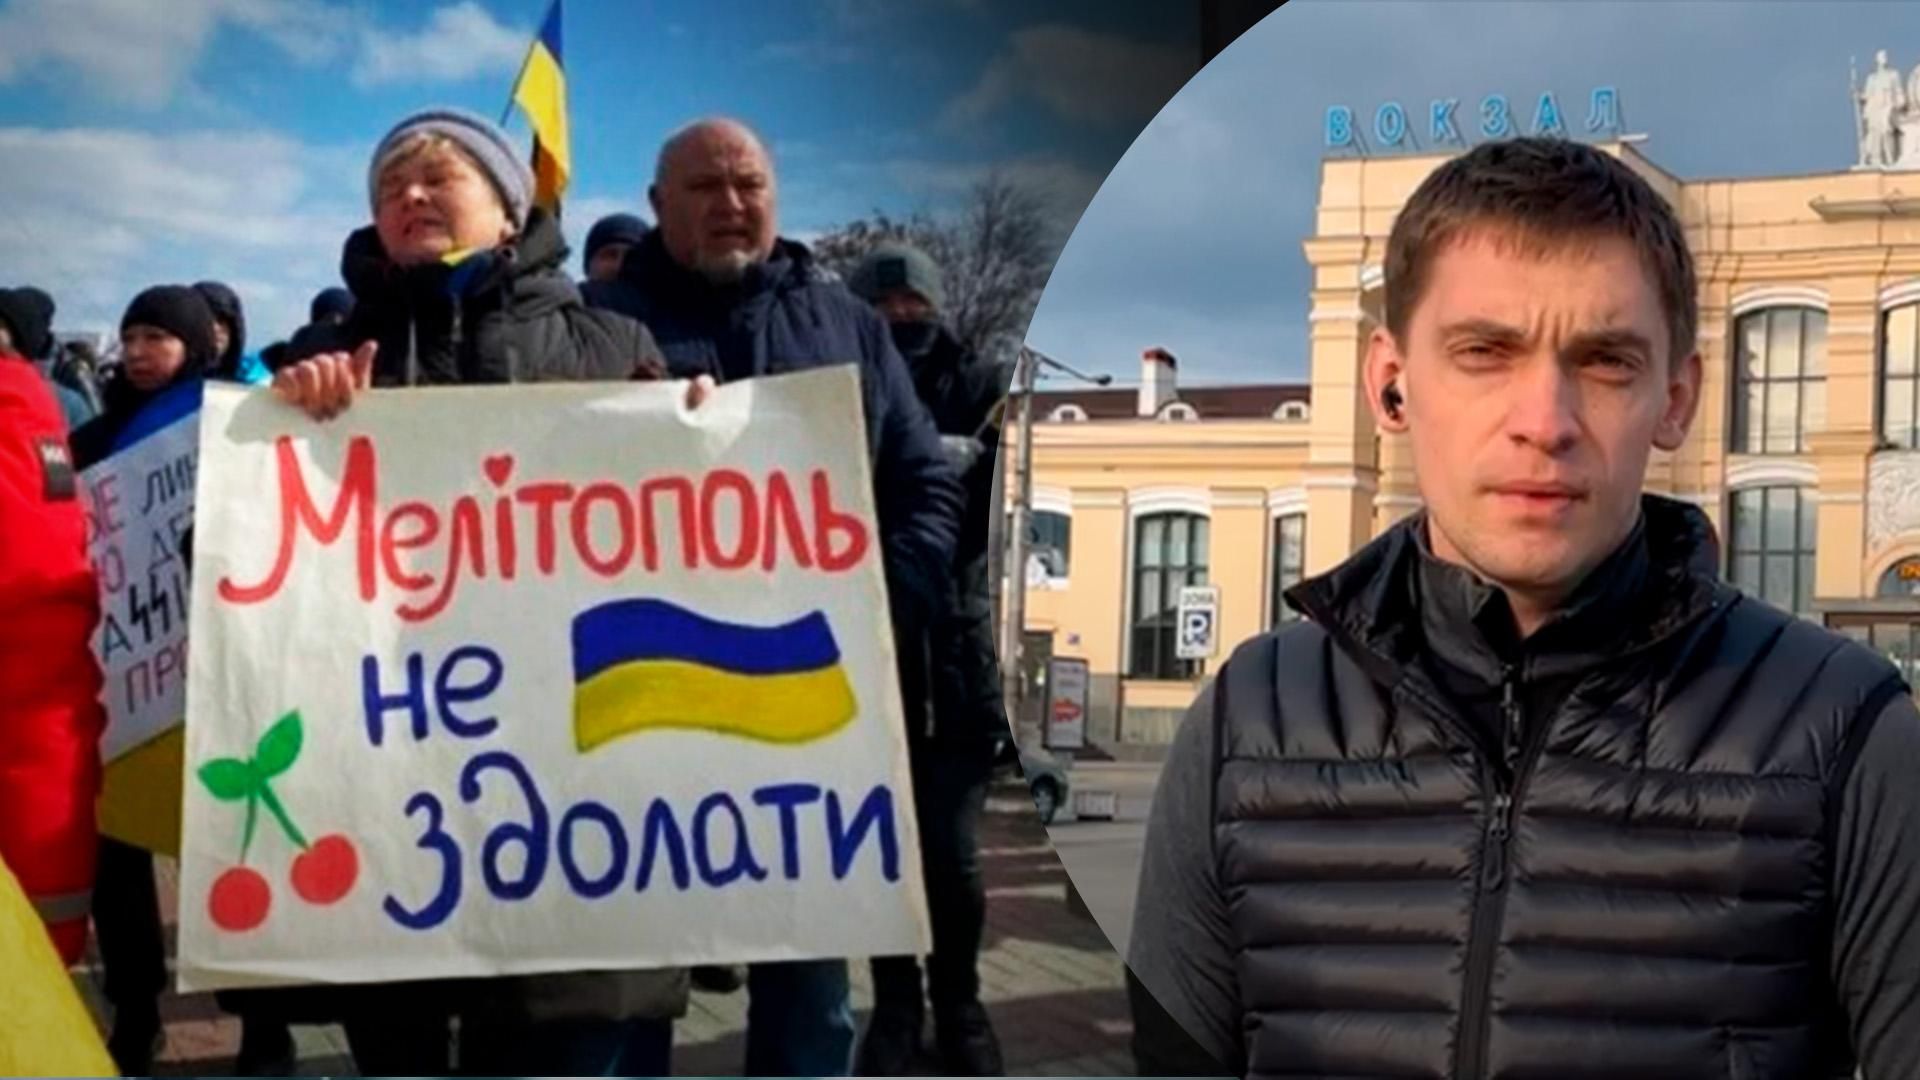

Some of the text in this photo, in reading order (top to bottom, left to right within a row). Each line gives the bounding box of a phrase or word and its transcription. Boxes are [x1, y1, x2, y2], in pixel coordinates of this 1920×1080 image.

[1325, 86, 1619, 146] ВОКЗАЛ
[218, 435, 870, 622] Мелітополь
[363, 646, 504, 746] не
